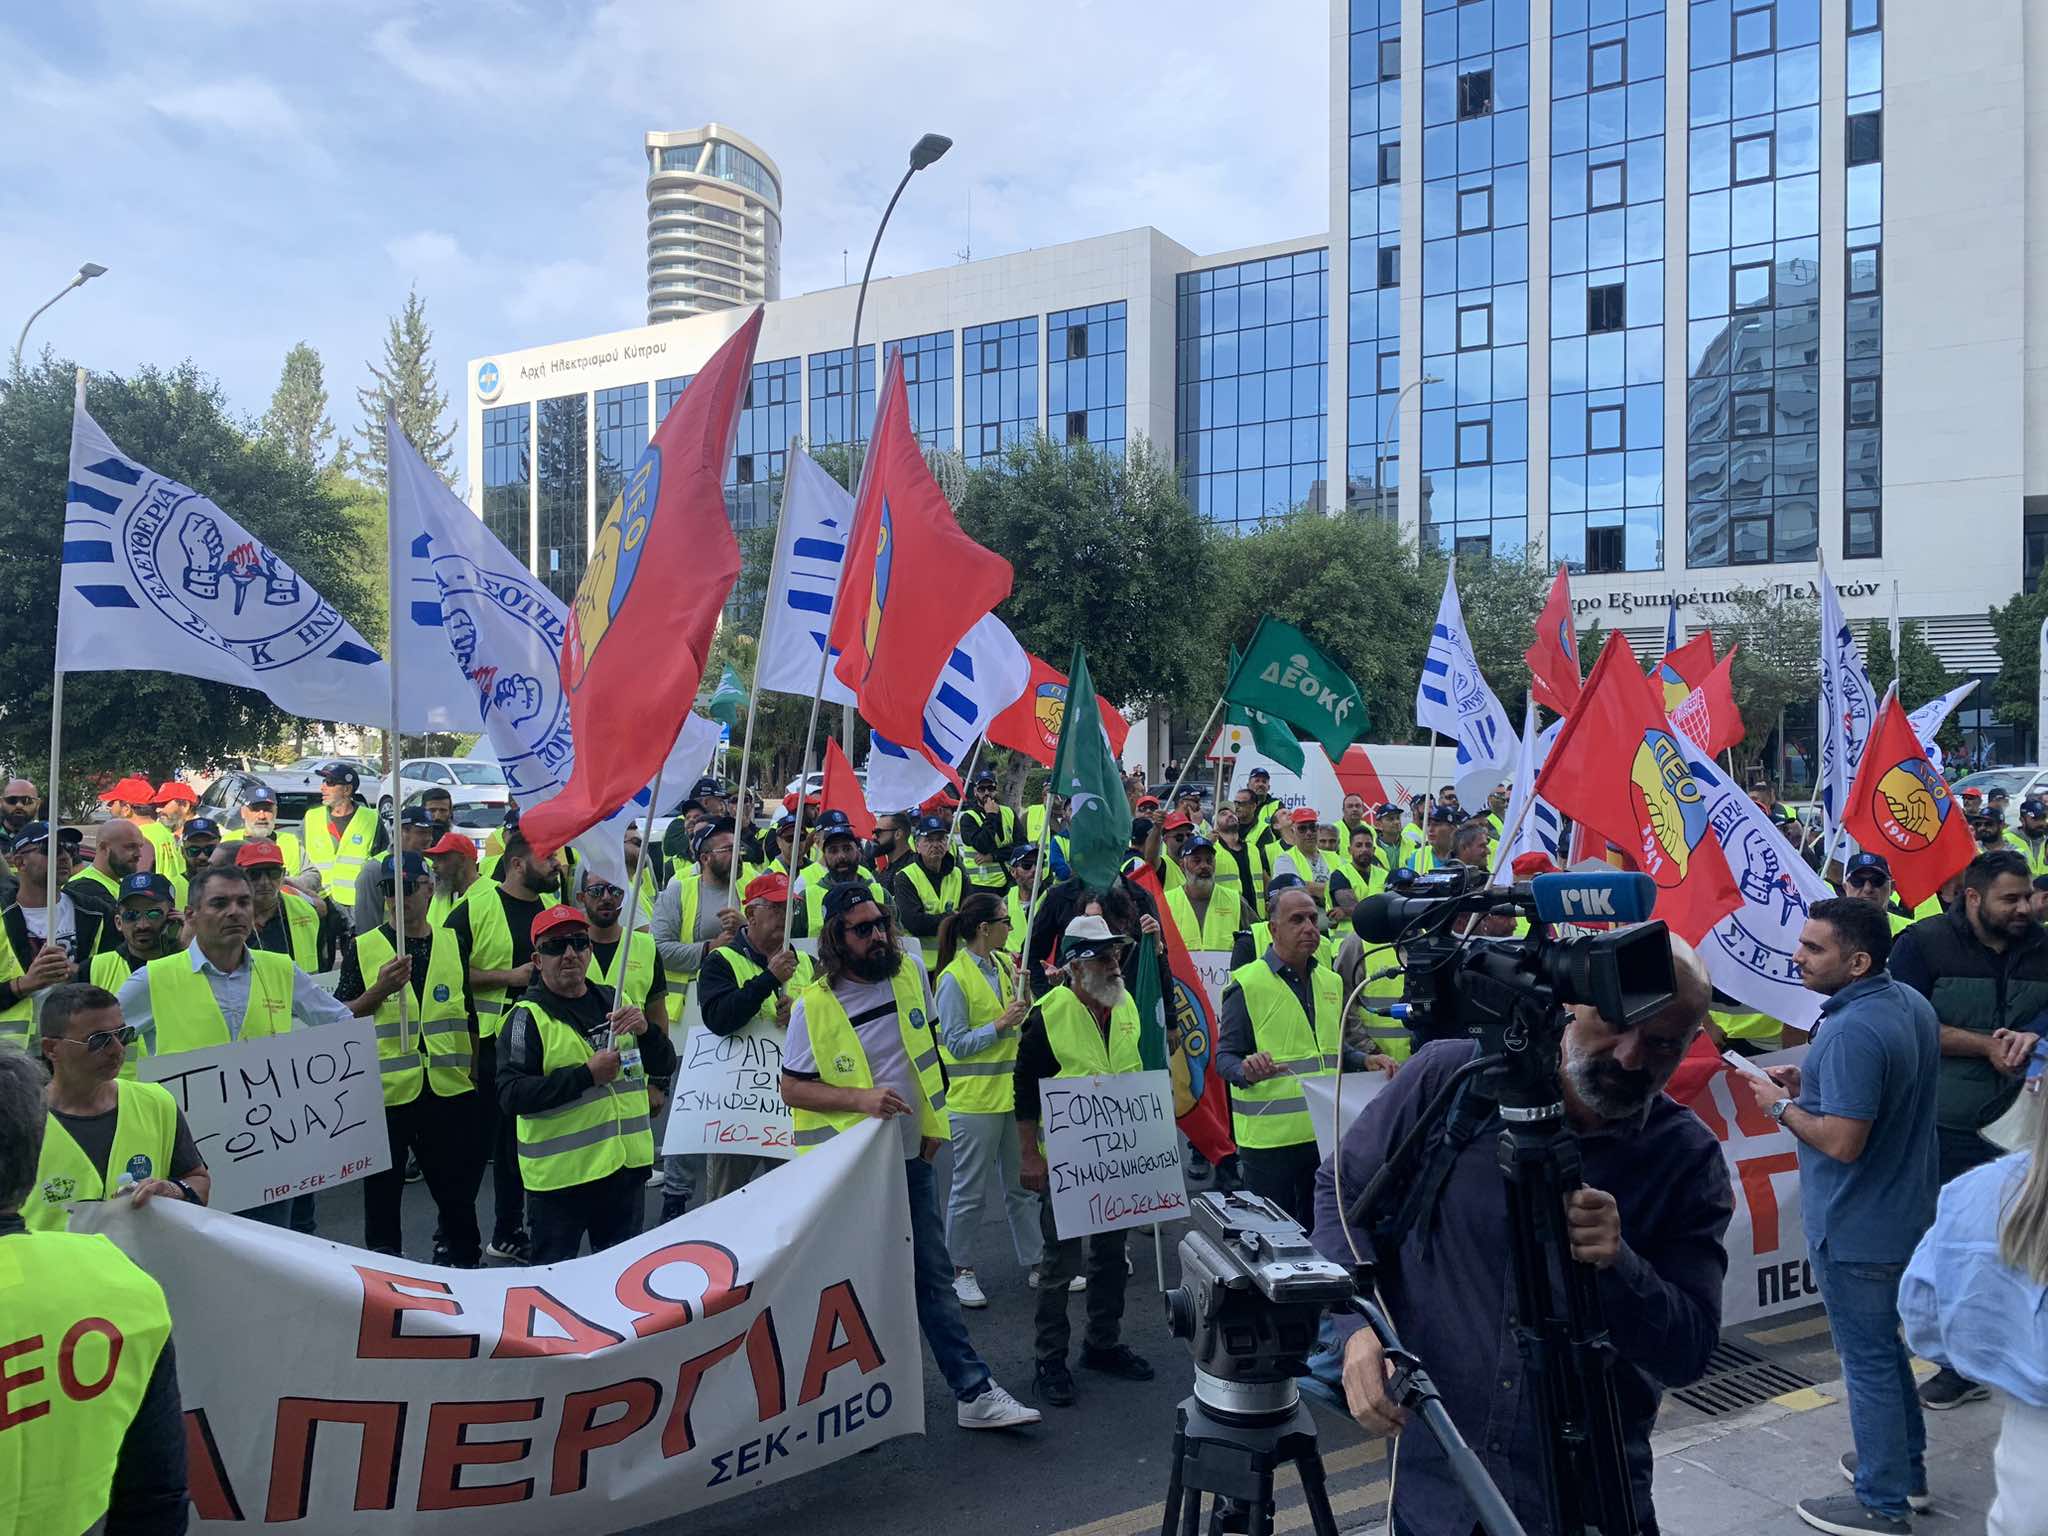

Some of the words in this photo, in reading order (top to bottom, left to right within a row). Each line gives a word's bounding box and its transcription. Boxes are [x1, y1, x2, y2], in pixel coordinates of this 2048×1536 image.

[520, 362, 547, 380] Αρχή
[550, 347, 619, 374] Ηλεκτρισμού
[624, 341, 668, 360] Κύπρου
[130, 487, 180, 600] ΕΛΕΥΘΕΡΙΑ
[1774, 581, 1882, 602] Πελτών
[1259, 661, 1339, 713] ΔΕΟΚ
[1654, 734, 1701, 804] ΠΕΟ
[1641, 823, 1664, 876] 1941
[1884, 819, 1911, 847] 1941
[155, 1040, 366, 1113] ΤΙΜΙΟΣ
[193, 1089, 368, 1170] ΓΩΝΑΣ
[245, 1103, 272, 1126] Ο
[1045, 1091, 1164, 1134] ΕΦΑΡΜΟΓΗ
[1081, 1128, 1137, 1158] ΤΩΝ
[351, 1239, 754, 1360] ΕΔΩ
